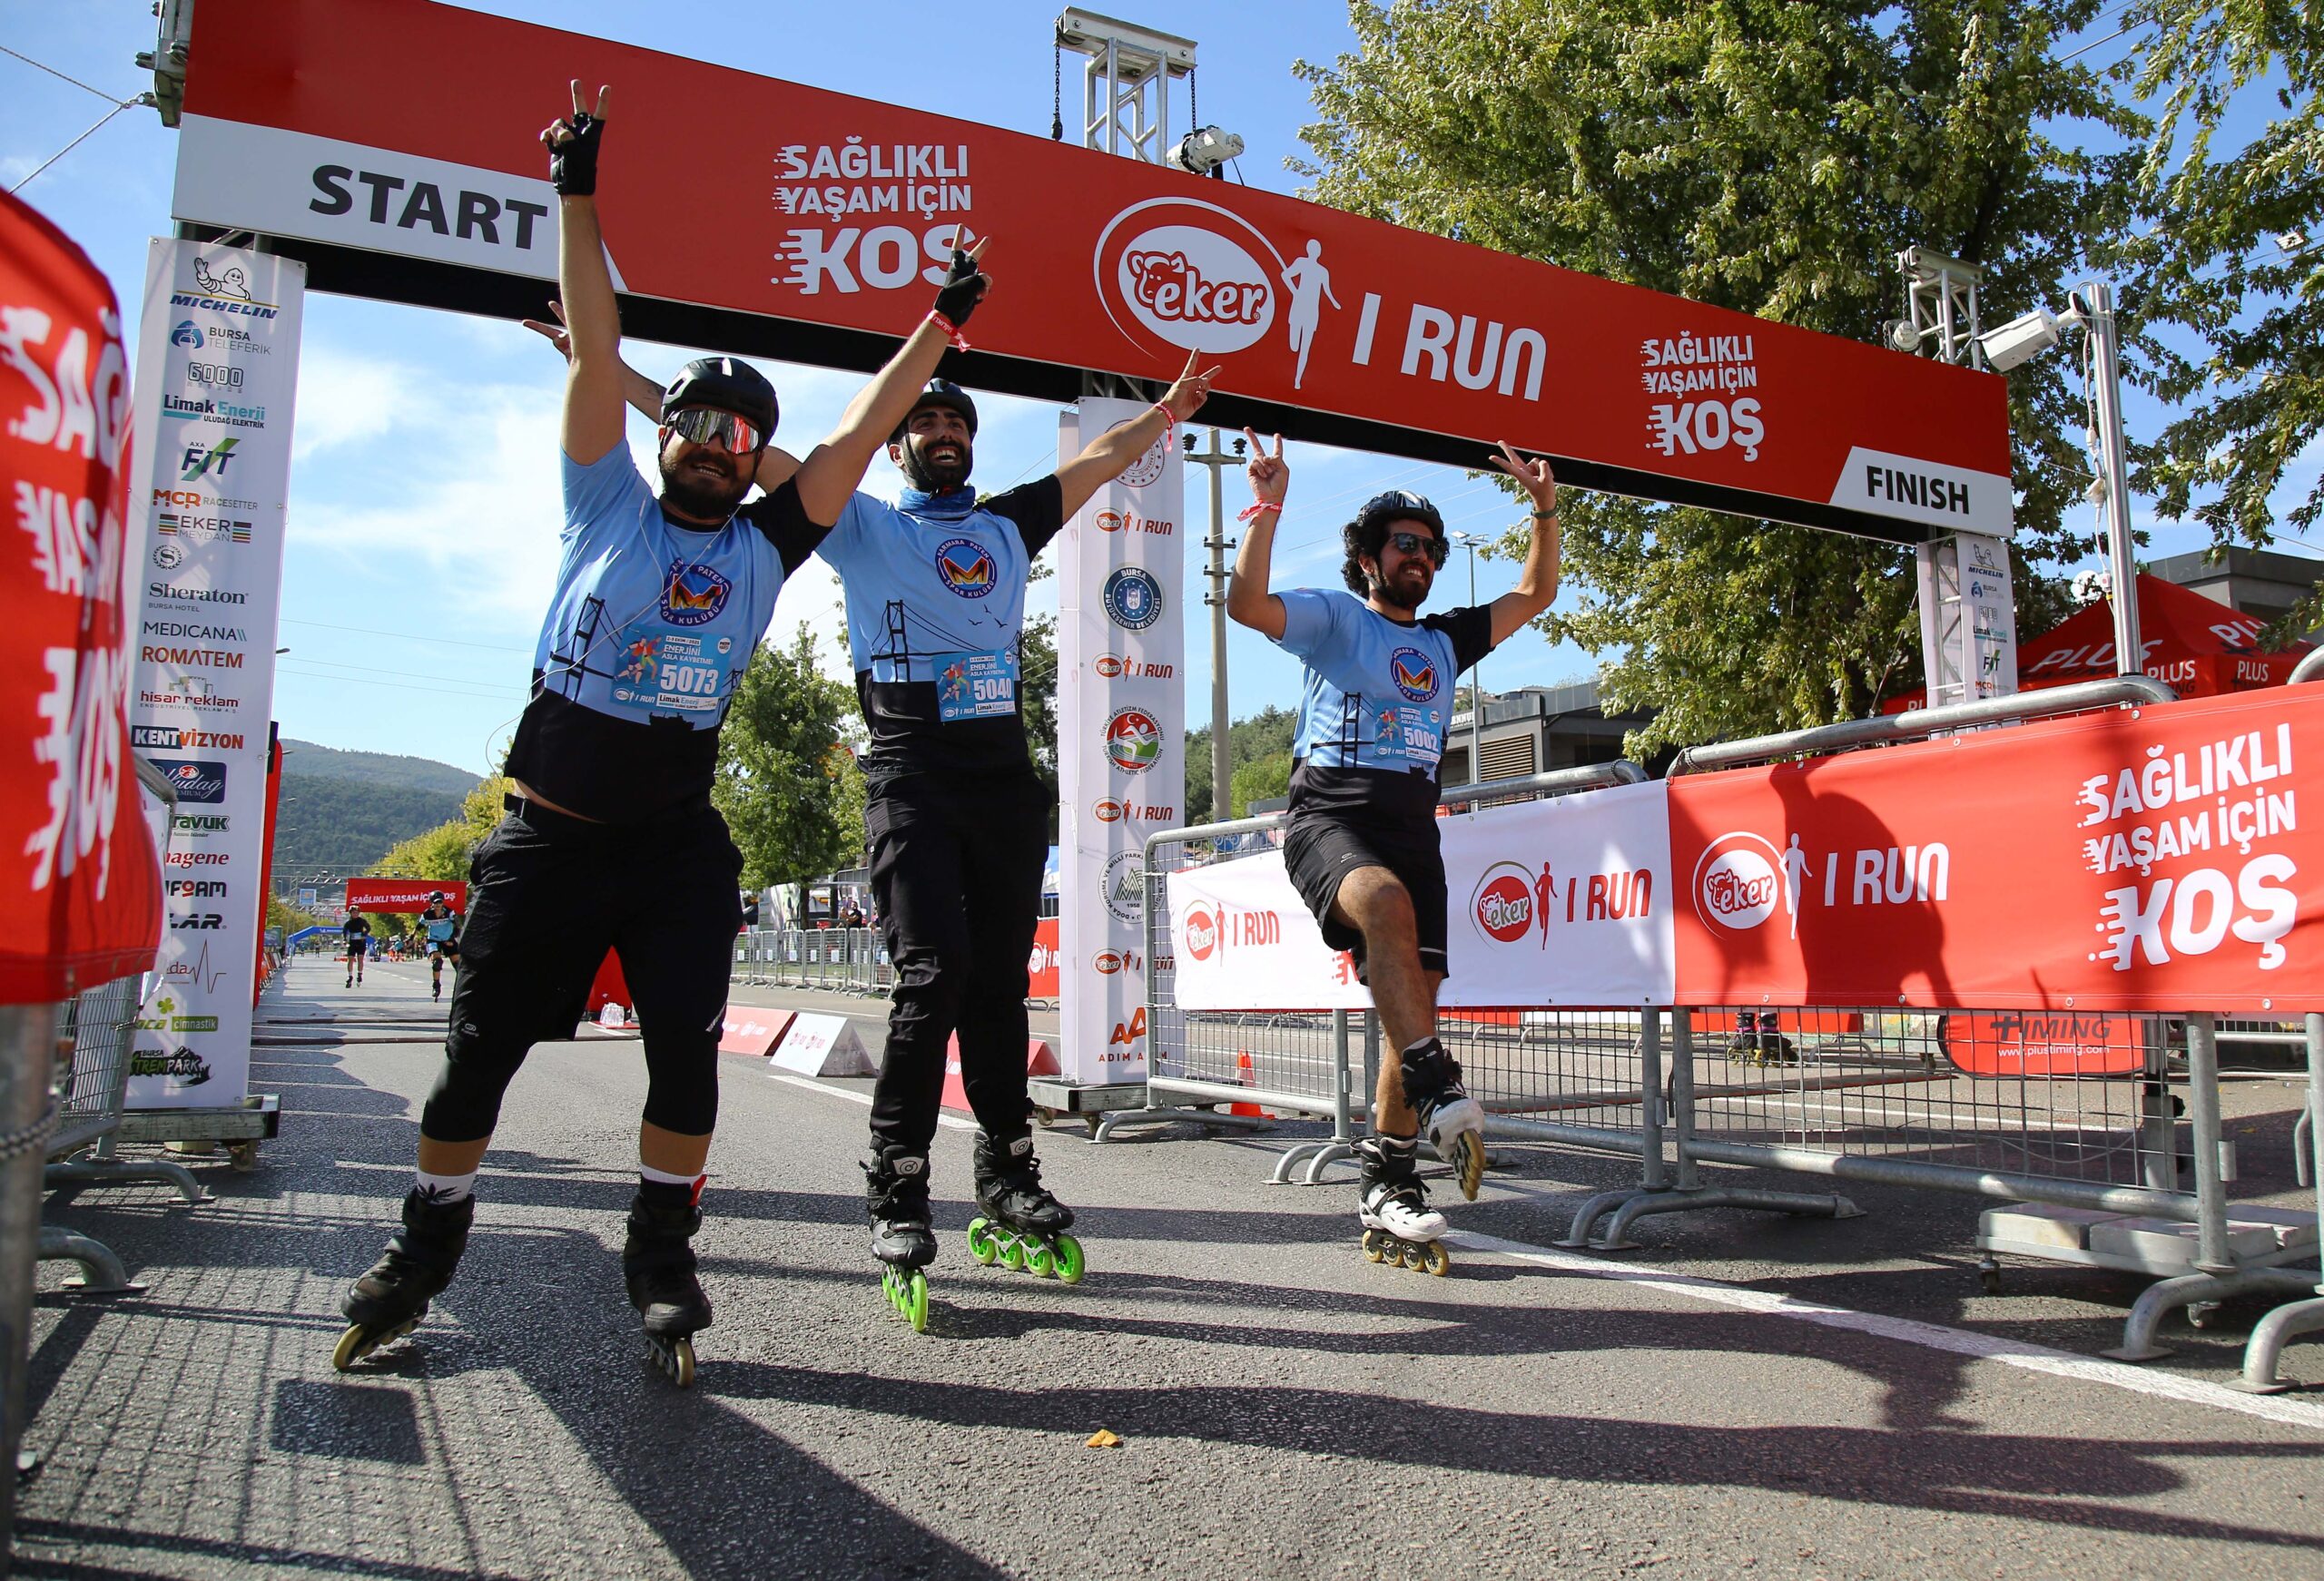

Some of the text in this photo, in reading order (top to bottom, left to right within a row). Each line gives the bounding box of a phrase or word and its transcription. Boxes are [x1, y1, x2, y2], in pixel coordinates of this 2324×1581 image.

[773, 135, 969, 180] SAĞLIKLI
[310, 164, 548, 250] START
[772, 178, 971, 222] YAŞAM İÇİN
[170, 295, 278, 319] MICHELIN
[209, 327, 251, 341] BURSA
[1153, 270, 1546, 401] eker I RUN
[209, 338, 271, 355] TELEFERİK
[1640, 330, 1753, 367] SAĞLIKLI
[188, 362, 243, 387] 6000
[1641, 361, 1757, 399] YAŞAM İÇİN
[163, 394, 265, 420] Limak Enerji
[203, 415, 264, 428] ULUDAĞ ELEKTRİK
[1645, 397, 1765, 462] KOŞ
[153, 489, 258, 510] MCR RACESETTER
[1866, 465, 1970, 515] FINISH
[181, 516, 231, 532] EKER
[1136, 519, 1141, 531] I
[1145, 520, 1172, 535] RUN
[179, 530, 230, 543] MEYDAN
[970, 542, 990, 558] PATEN
[698, 565, 724, 584] PATEN
[1120, 568, 1147, 580] BURSA
[1968, 566, 2004, 579] MICHELIN
[149, 582, 246, 604] Sheraton
[945, 579, 964, 595] SPOR
[148, 603, 200, 613] BURSA HOTEL
[678, 604, 719, 624] KULÜBÜ
[143, 621, 238, 642] MEDICANA
[142, 646, 244, 668] ROMATEM
[664, 644, 701, 656] ENERJİNİ
[660, 663, 719, 694] 5073
[1136, 663, 1141, 676] I
[1145, 663, 1173, 679] RUN
[2148, 660, 2195, 682] PLUS
[2238, 660, 2269, 682] PLUS
[141, 691, 240, 708] hisar reklam
[659, 694, 680, 703] Limak
[973, 678, 1012, 701] 5040
[1403, 726, 1440, 752] 5002
[2076, 722, 2294, 828] SAĞLIKLI
[1136, 806, 1141, 820] I
[1145, 806, 1173, 821] RUN
[2083, 786, 2297, 878] YAŞAM İÇİN
[1720, 842, 1949, 912] eker I RUN
[351, 894, 389, 904] SAĞLIKLI
[389, 894, 419, 904] YAŞAM
[444, 892, 456, 901] OŞ
[1491, 869, 1652, 929] eker I RUN
[2088, 853, 2298, 971] KOŞ
[1192, 910, 1280, 950] eker I RUN
[1136, 957, 1141, 971] I
[1154, 957, 1175, 970] UN
[173, 1020, 217, 1029] cimnastik
[1098, 1053, 1131, 1062] ADIM
[1998, 1045, 2110, 1057] www.plustiming.com
